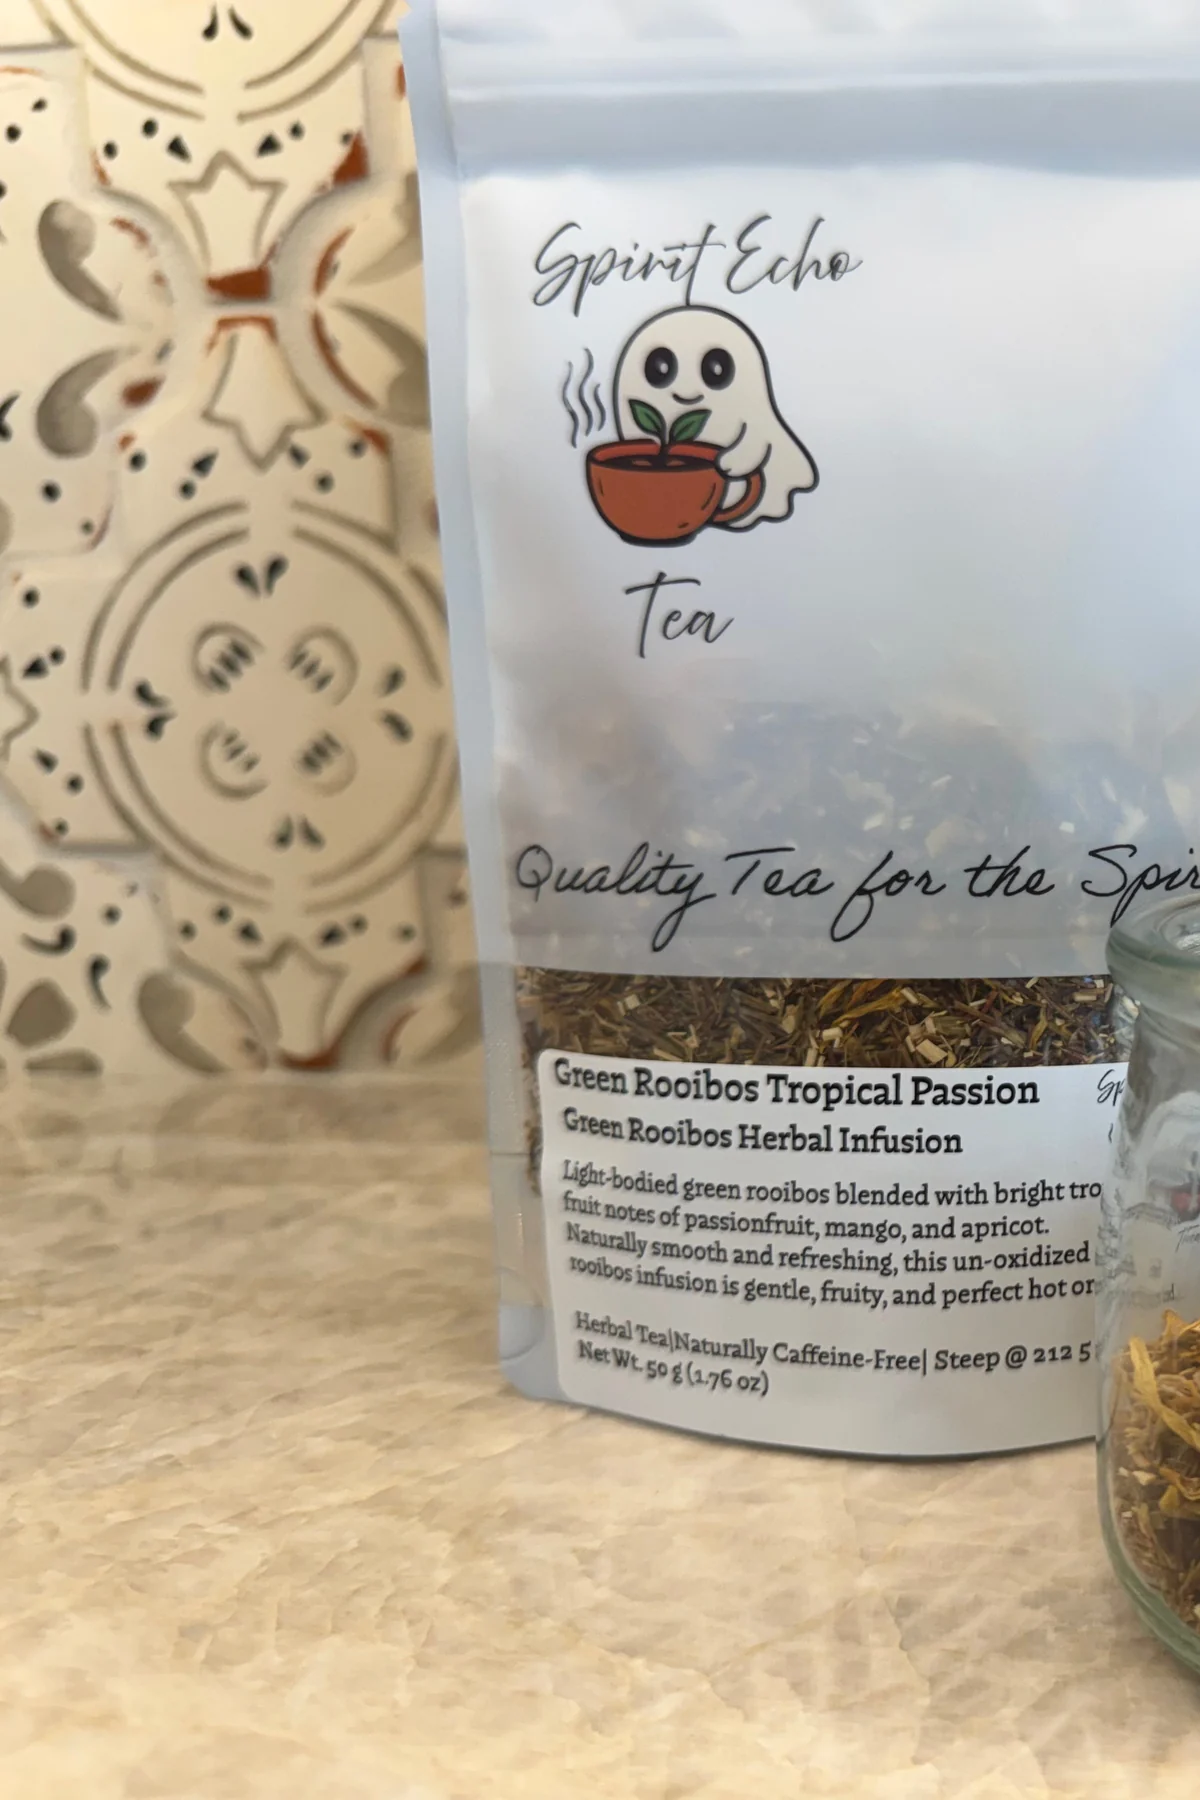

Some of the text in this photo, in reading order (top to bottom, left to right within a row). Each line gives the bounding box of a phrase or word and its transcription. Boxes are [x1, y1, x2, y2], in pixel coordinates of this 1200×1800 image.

[533, 215, 863, 317] Spirit Echo
[624, 572, 735, 658] Tea
[516, 842, 716, 952] Quality
[725, 847, 834, 897] Tea
[830, 850, 946, 942] for
[964, 845, 1055, 897] the
[554, 1057, 1040, 1112] Green Rooibos Tropical Passion
[563, 1106, 963, 1153] Green Rooibos Herbal Infusion
[563, 1159, 1102, 1207] Light-bodied green rooibos blended with bright tro
[563, 1190, 1049, 1243] fruit notes of passionfruit, mango, and apricot.
[566, 1221, 1091, 1276] Naturally smooth and refreshing, this un-oxidized
[569, 1256, 1095, 1310] rooibos infusion is gentle, fruity, and perfect hot or
[575, 1310, 633, 1341] Herbal
[934, 1349, 1000, 1372] Steep
[1005, 1345, 1028, 1369] @
[1033, 1346, 1073, 1364] 212
[577, 1339, 611, 1364] Net
[612, 1348, 643, 1373] Wt.
[687, 1360, 732, 1391] (1.76
[737, 1370, 770, 1397] oz)
